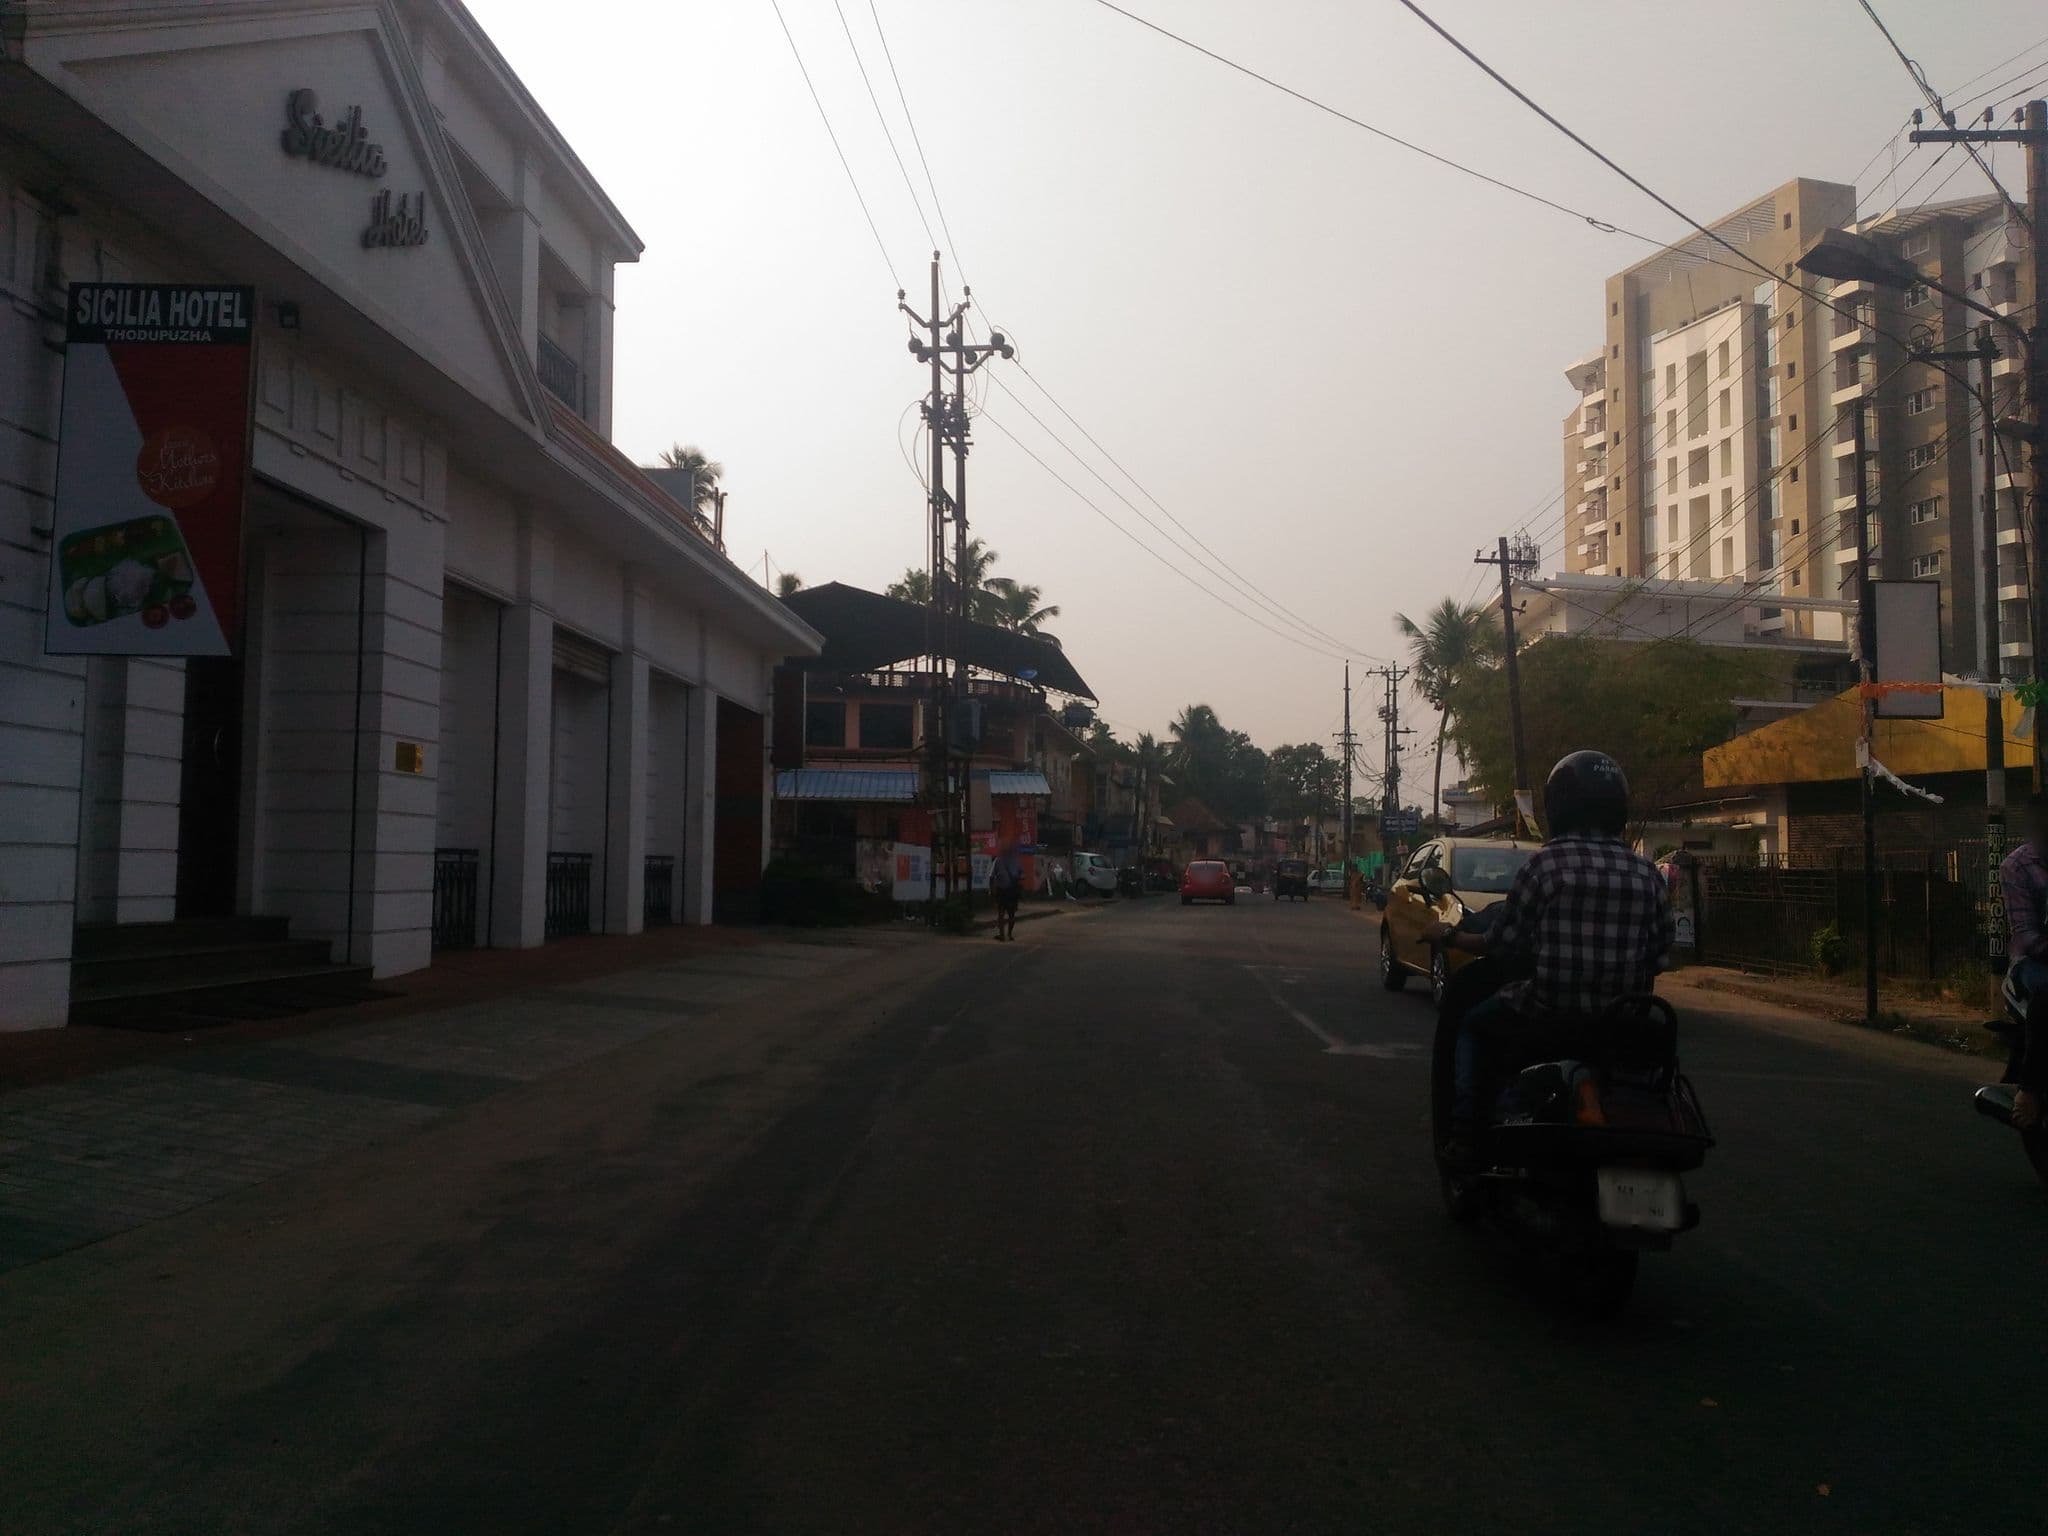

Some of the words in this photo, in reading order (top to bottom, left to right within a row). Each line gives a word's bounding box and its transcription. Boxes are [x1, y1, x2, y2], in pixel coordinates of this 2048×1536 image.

[361, 188, 429, 249] Hotel
[77, 287, 161, 326] SICILIA
[168, 290, 247, 328] HOTEL
[104, 328, 212, 342] THODUPUZHA
